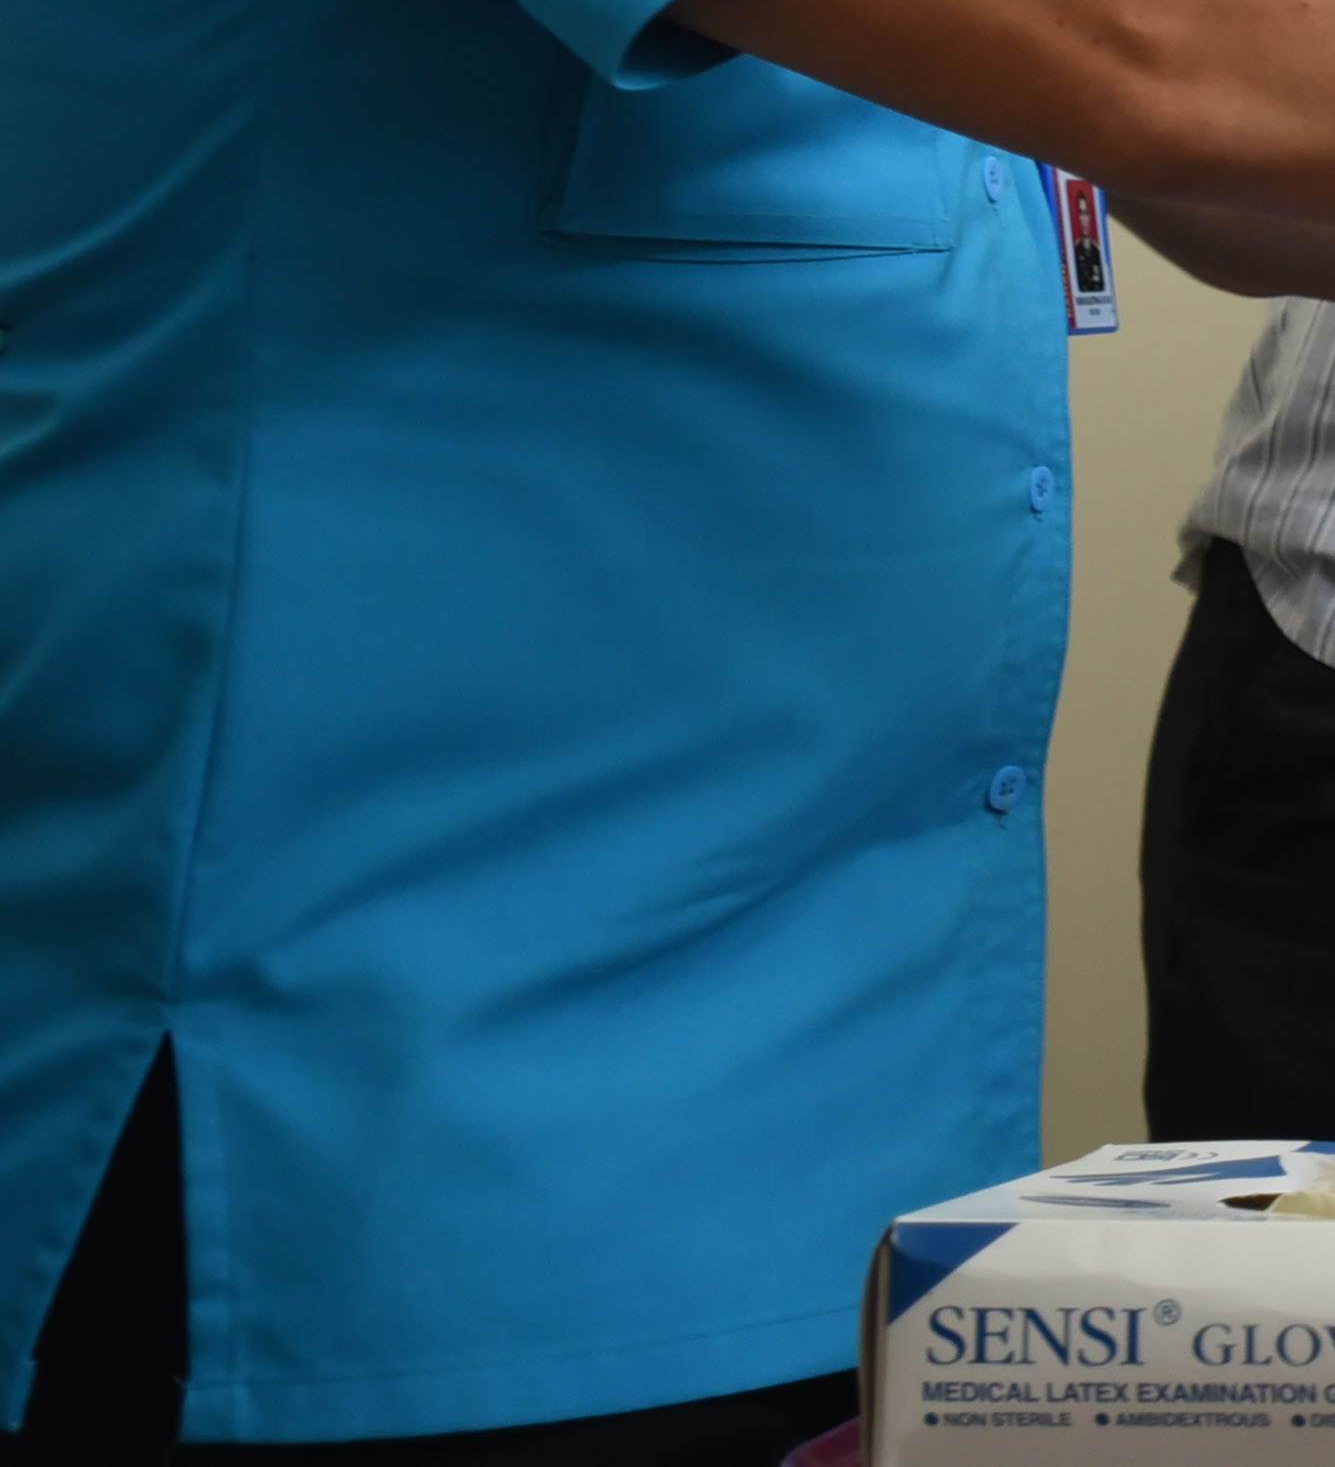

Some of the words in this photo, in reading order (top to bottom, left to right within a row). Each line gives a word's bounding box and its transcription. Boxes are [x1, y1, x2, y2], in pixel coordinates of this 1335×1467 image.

[921, 1381, 1040, 1403] MEDICAL
[1046, 1382, 1130, 1404] LATEX
[1137, 1382, 1317, 1405] EXAMINATION
